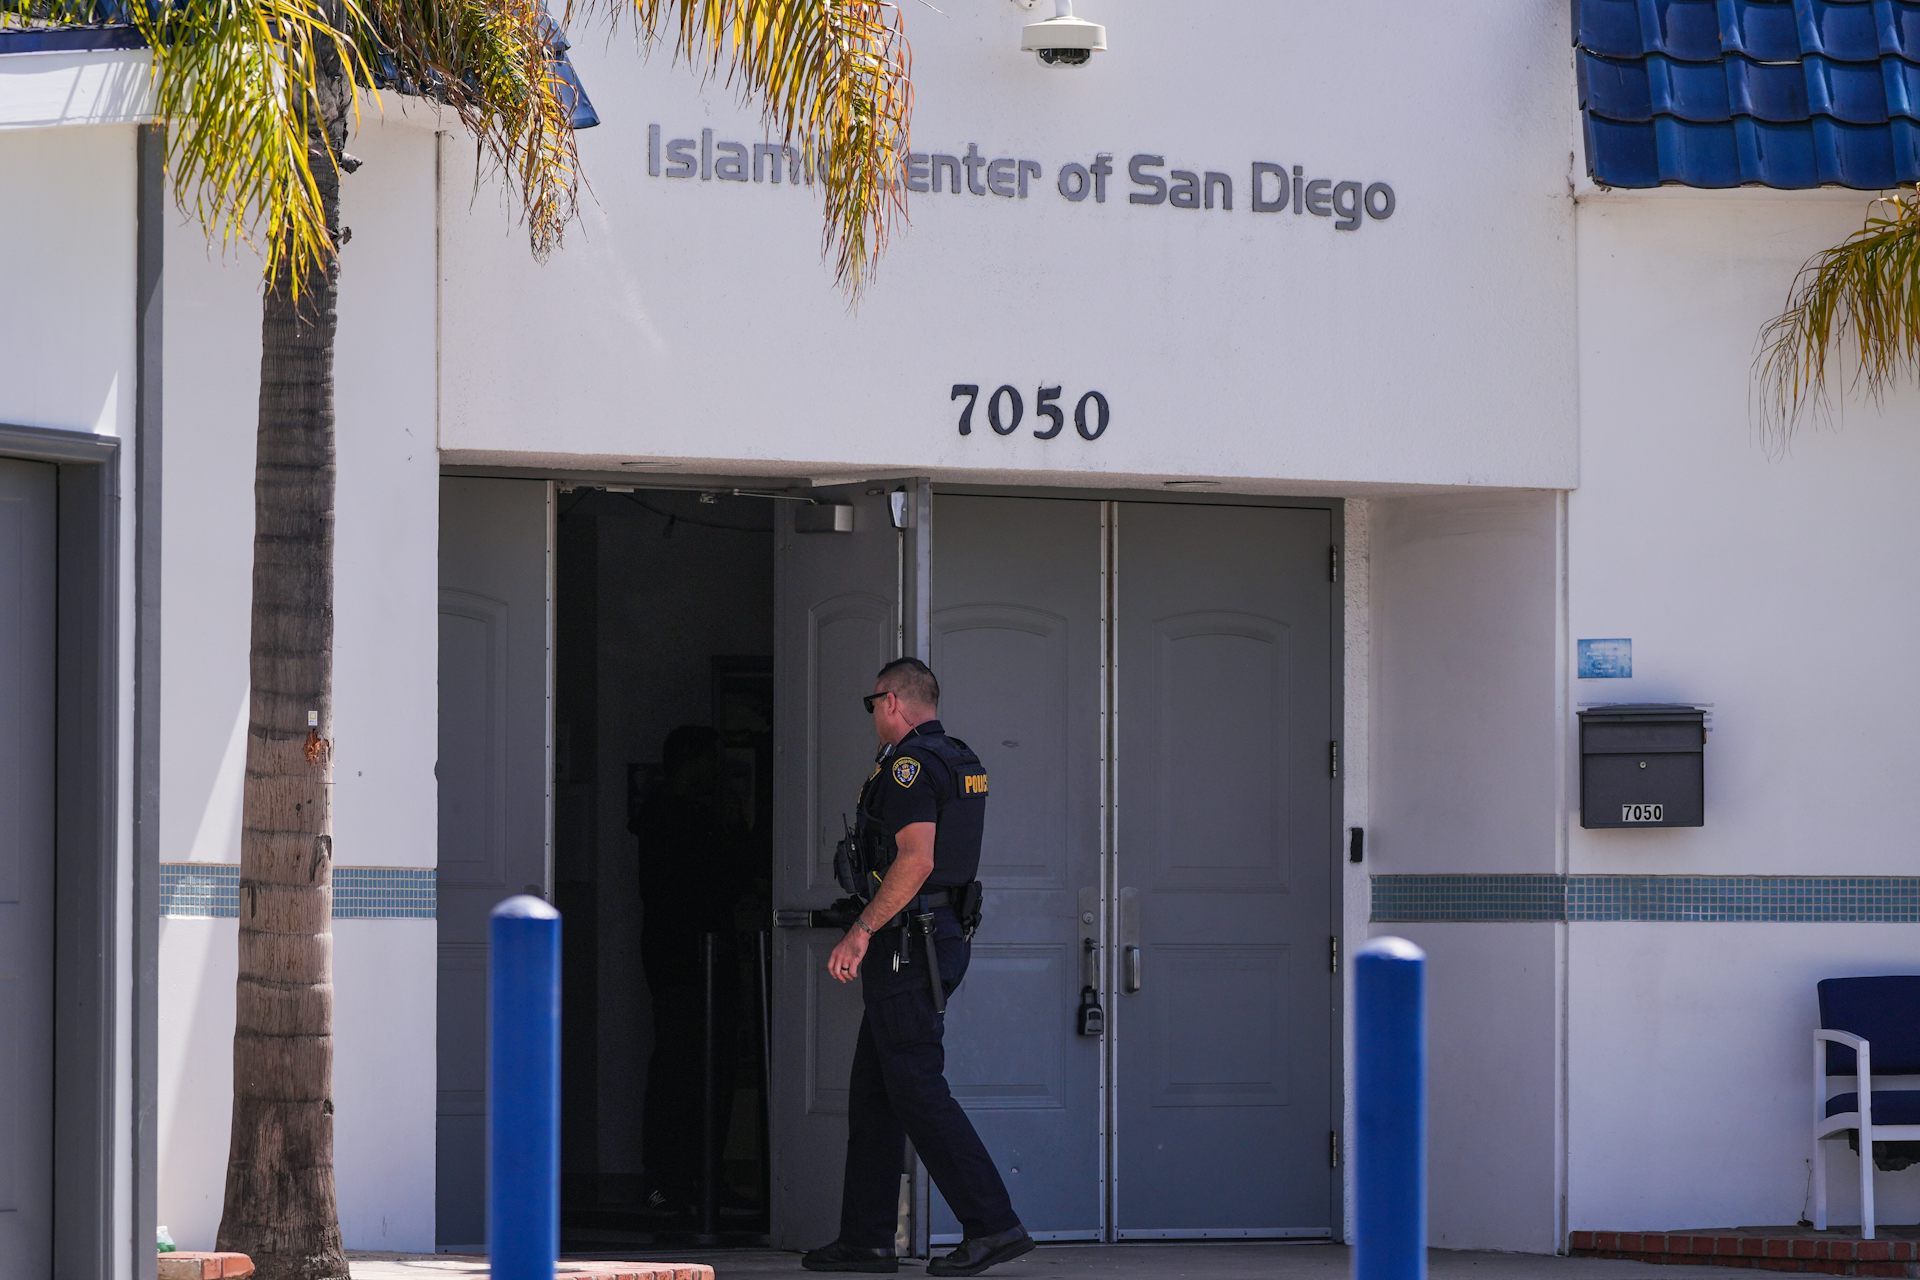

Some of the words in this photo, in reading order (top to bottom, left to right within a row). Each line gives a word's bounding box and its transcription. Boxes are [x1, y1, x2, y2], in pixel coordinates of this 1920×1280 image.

[1057, 151, 1113, 203] of
[1127, 153, 1233, 211] San
[1251, 161, 1397, 231] Diego
[950, 384, 1110, 441] 7050
[1623, 805, 1662, 821] 7050
